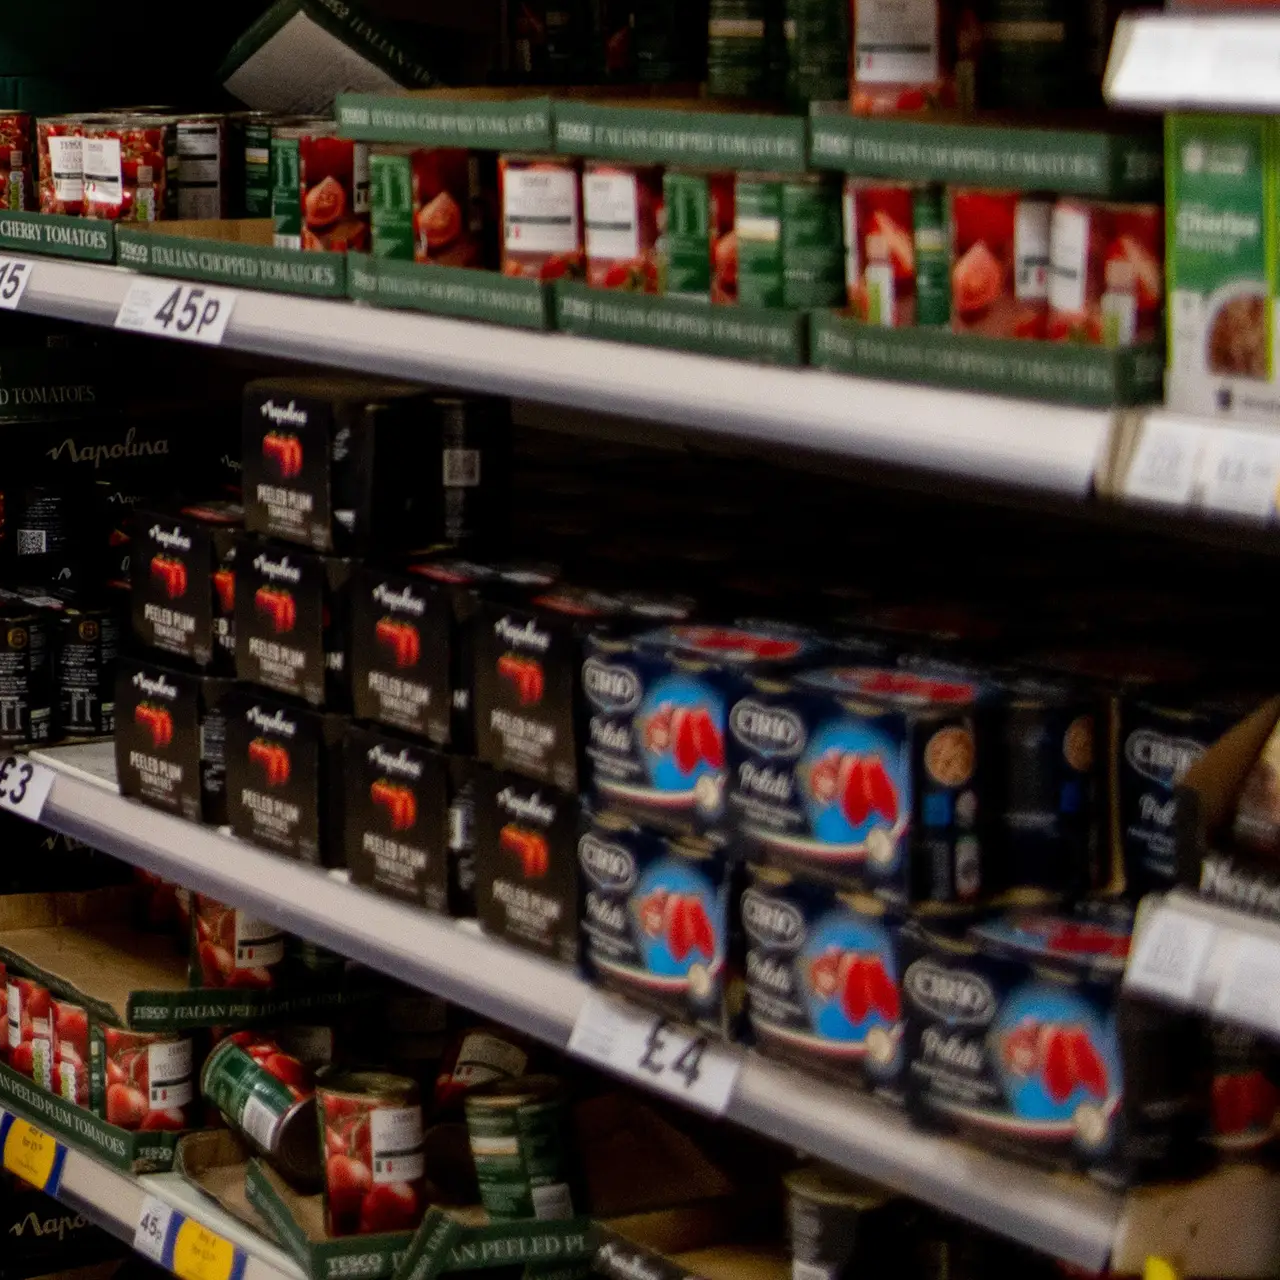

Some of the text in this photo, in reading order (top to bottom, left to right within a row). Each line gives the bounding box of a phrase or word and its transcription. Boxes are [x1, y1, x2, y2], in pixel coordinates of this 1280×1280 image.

[0, 219, 42, 242] CHERRY
[42, 225, 107, 250] TOMATOES
[151, 245, 196, 269] ITALIAN
[197, 251, 258, 276] CHOPPED
[259, 259, 336, 286] TOMATOES
[154, 285, 221, 335] 45p
[14, 384, 96, 404] TOMATOES
[45, 426, 169, 468] Napolina
[638, 1020, 709, 1089] £4
[11, 1078, 45, 1112] PEELED
[45, 1100, 73, 1131] PLUM
[74, 1114, 125, 1157] TOMATOES
[140, 1213, 163, 1243] 45p
